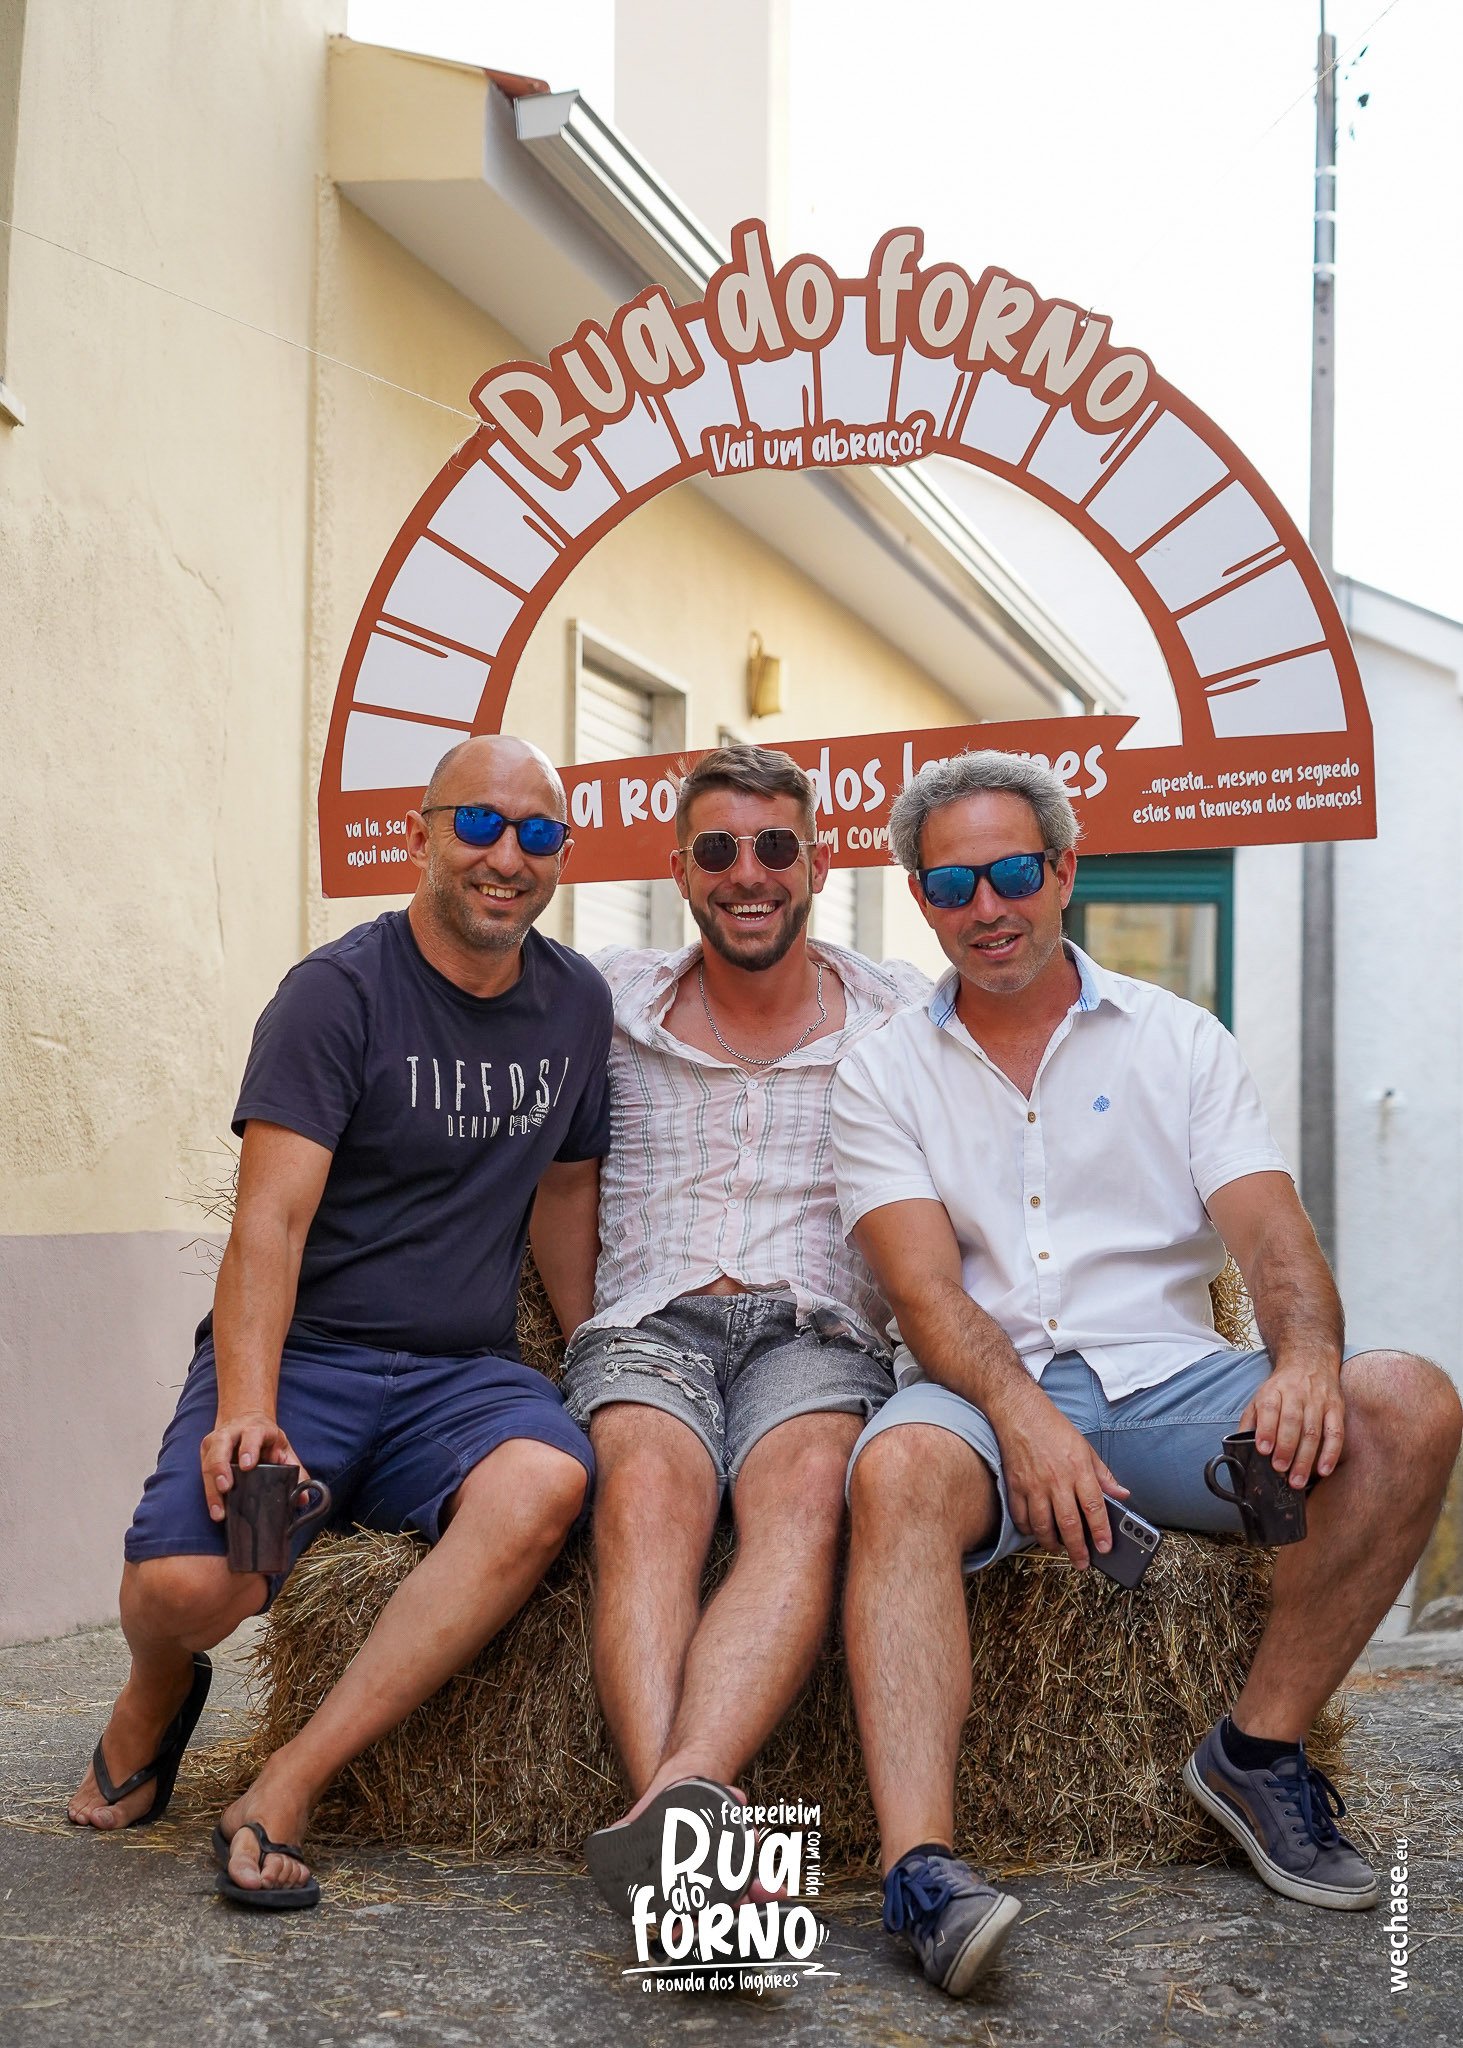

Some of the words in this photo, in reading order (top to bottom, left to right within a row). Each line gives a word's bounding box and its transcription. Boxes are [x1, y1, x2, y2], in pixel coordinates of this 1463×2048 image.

[478, 296, 694, 480] Rua
[717, 230, 835, 353] do
[709, 430, 755, 473] Vai
[763, 436, 803, 466] um
[812, 418, 928, 462] abraço?
[1217, 770, 1267, 789] mesmo
[1271, 767, 1293, 784] em
[1297, 757, 1360, 787] segredo
[571, 779, 603, 829] a
[1132, 803, 1171, 824] estás
[1175, 804, 1196, 820] na
[1199, 798, 1263, 819] travessa
[1266, 792, 1292, 813] dos
[1296, 785, 1363, 810] abraços!
[380, 846, 408, 863] não
